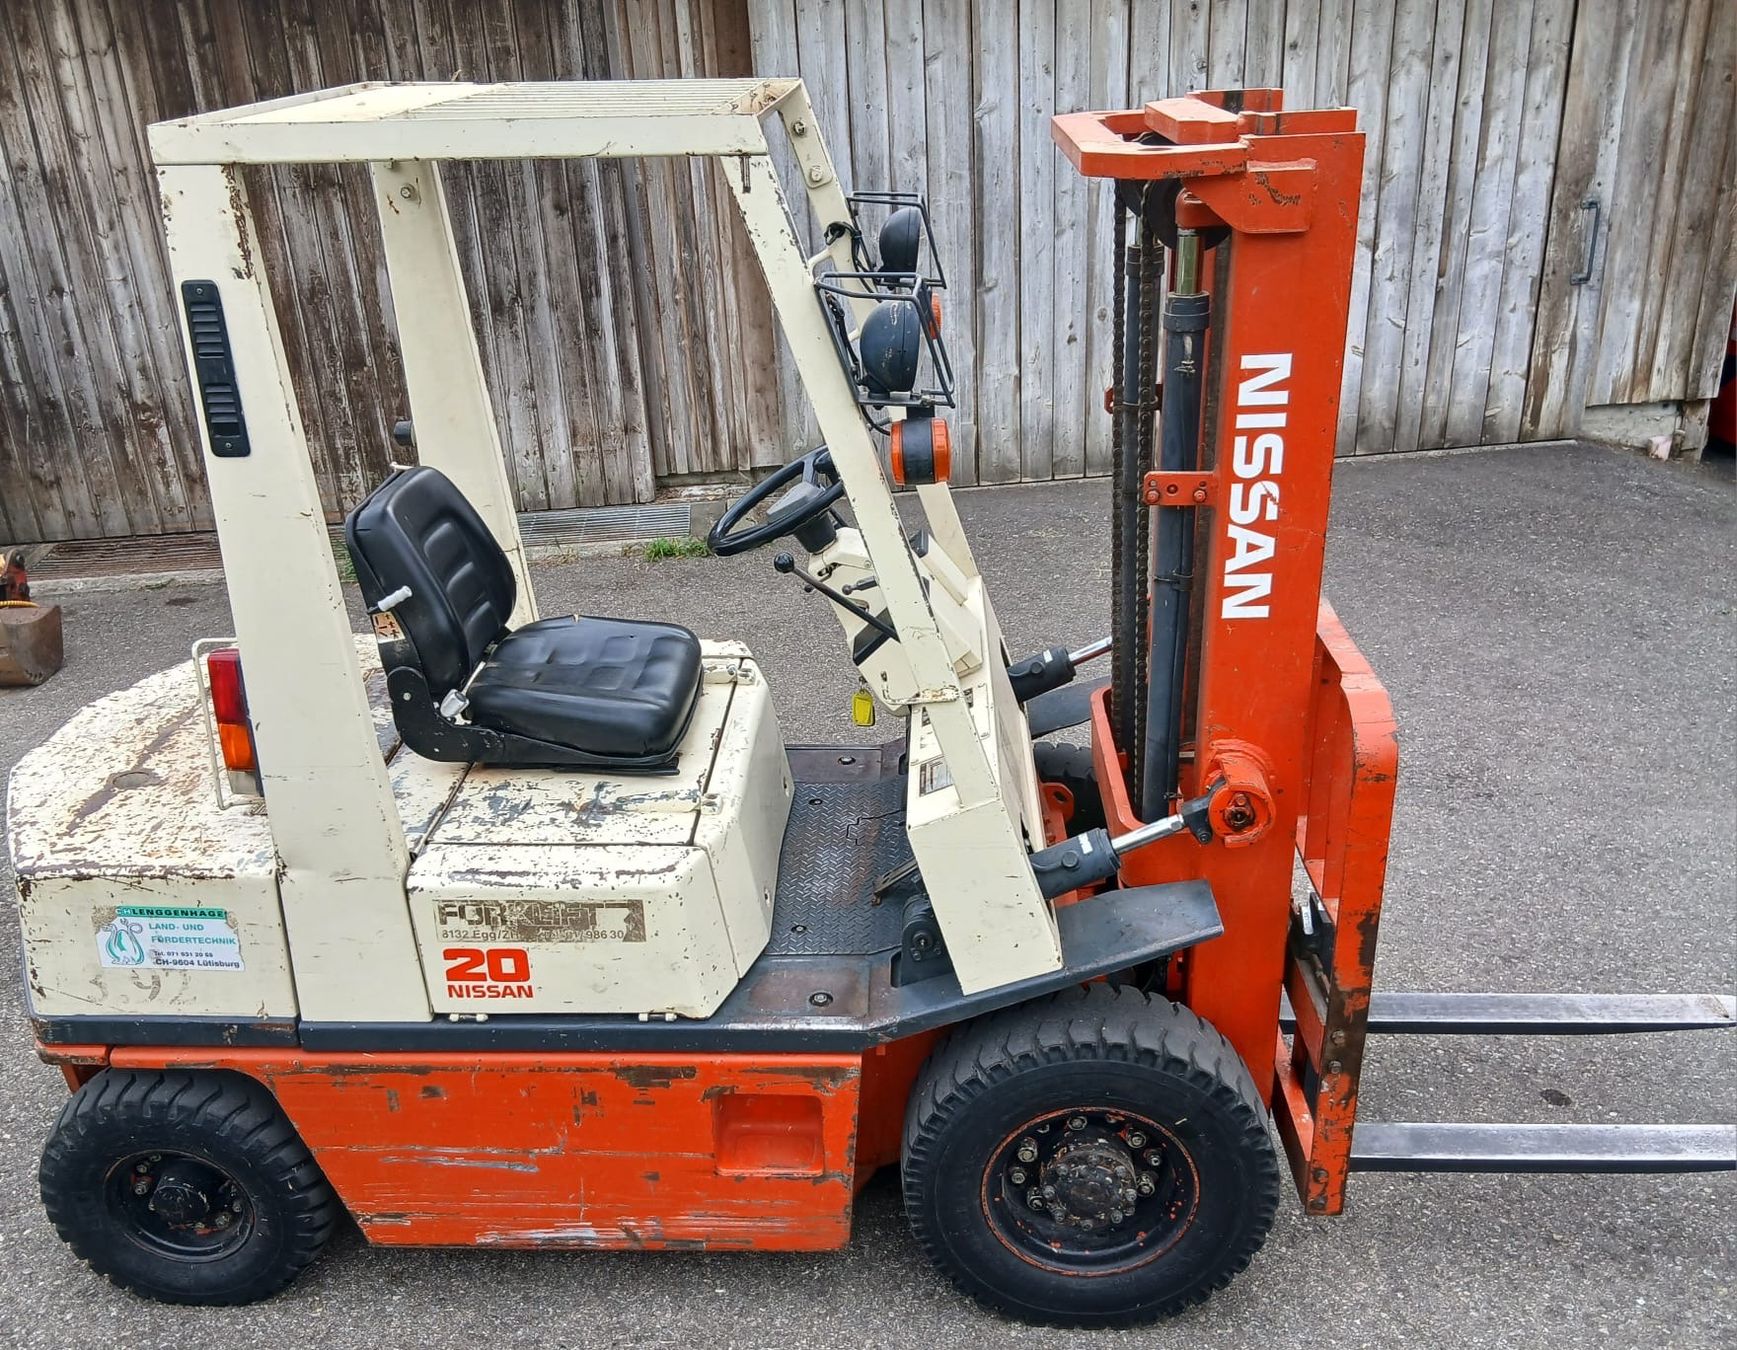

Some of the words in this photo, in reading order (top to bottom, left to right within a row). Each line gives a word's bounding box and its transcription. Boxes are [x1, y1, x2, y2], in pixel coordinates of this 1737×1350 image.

[1221, 352, 1293, 620] NISSAN
[148, 922, 179, 931] LAND-
[183, 923, 205, 932] UND
[442, 929, 469, 940] 8132
[585, 929, 608, 940] 986
[610, 929, 624, 940] 30
[151, 935, 237, 946] FÖRDERTECHNIK
[197, 959, 240, 970] Lütisburg
[442, 948, 531, 983] 20
[447, 984, 534, 999] NISSAN
